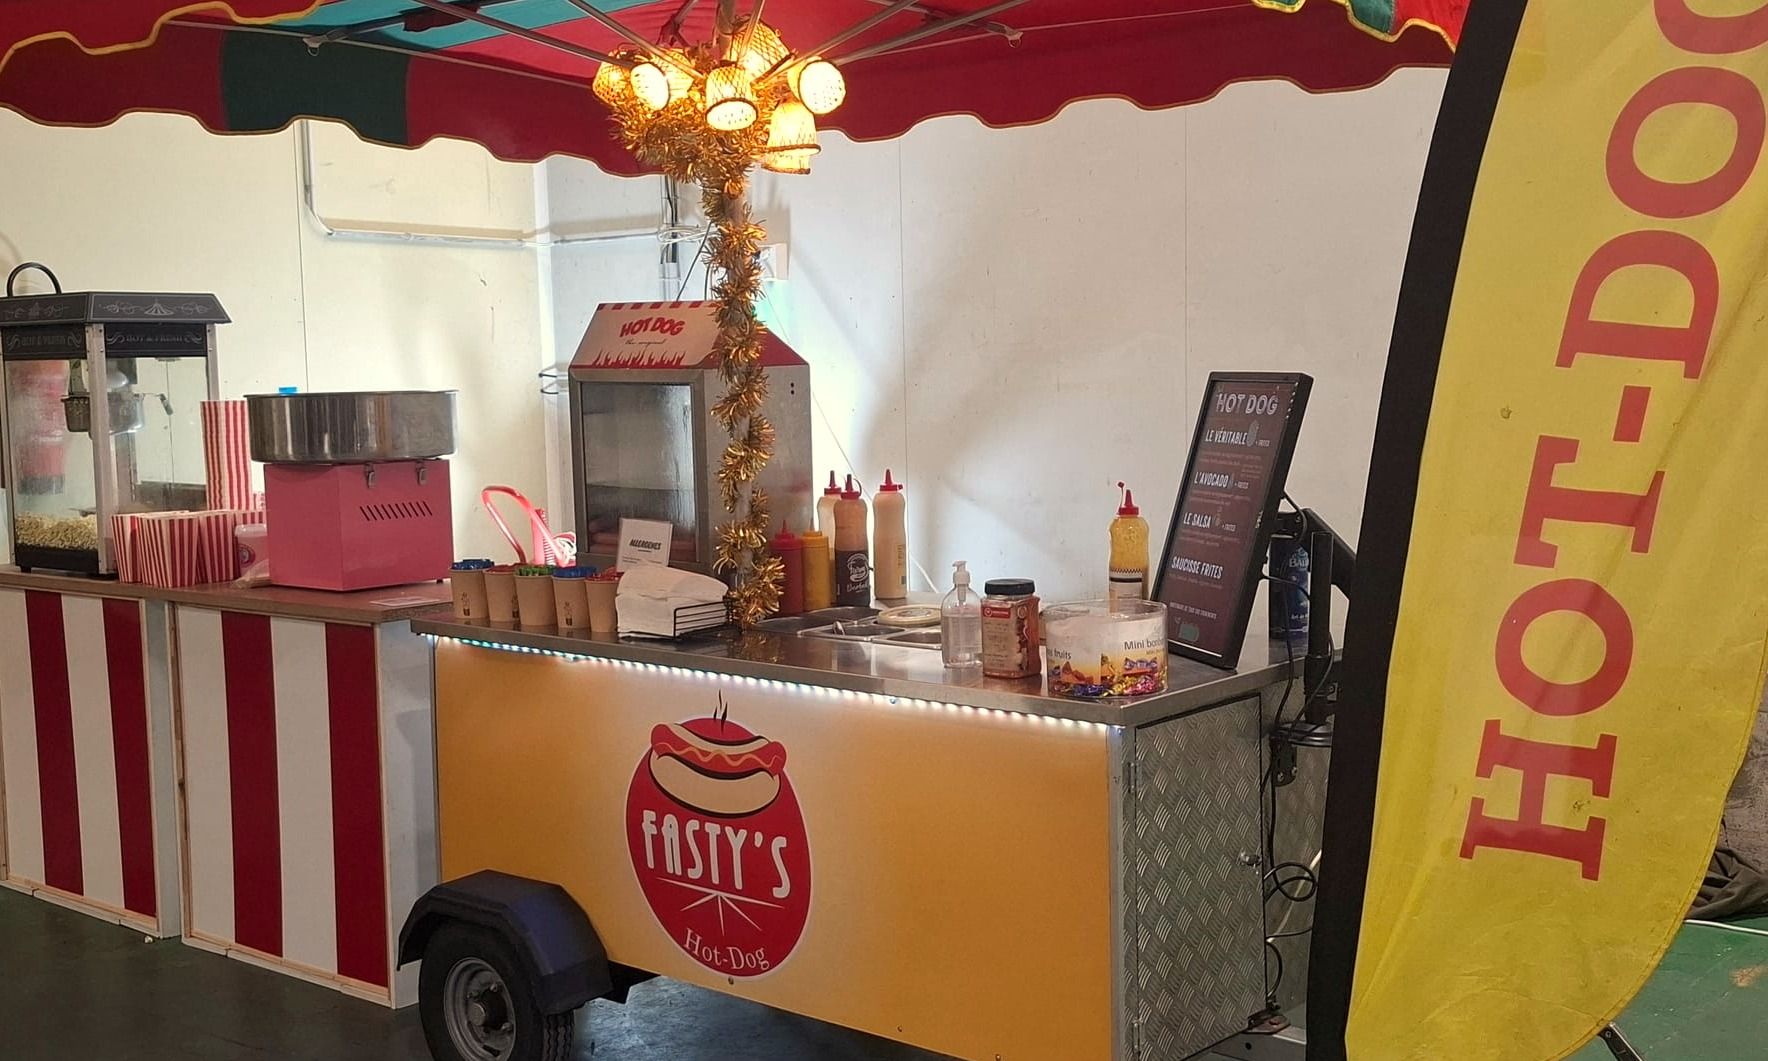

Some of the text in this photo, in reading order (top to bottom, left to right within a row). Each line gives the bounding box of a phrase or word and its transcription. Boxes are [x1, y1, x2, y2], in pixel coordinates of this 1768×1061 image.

[620, 317, 685, 337] HOT DOG
[1216, 393, 1279, 415] HOT DOG
[1205, 429, 1214, 442] LE
[1214, 426, 1248, 445] VÉRITABLE
[1194, 471, 1229, 488] L'AVOCADO
[1183, 512, 1192, 525] LE
[1192, 513, 1211, 529] SALSA
[1171, 556, 1223, 579] SAUCISSE FRITES
[1124, 640, 1144, 651] Mini
[641, 809, 791, 899] FASTY'S
[684, 927, 770, 971] Hot-Dog
